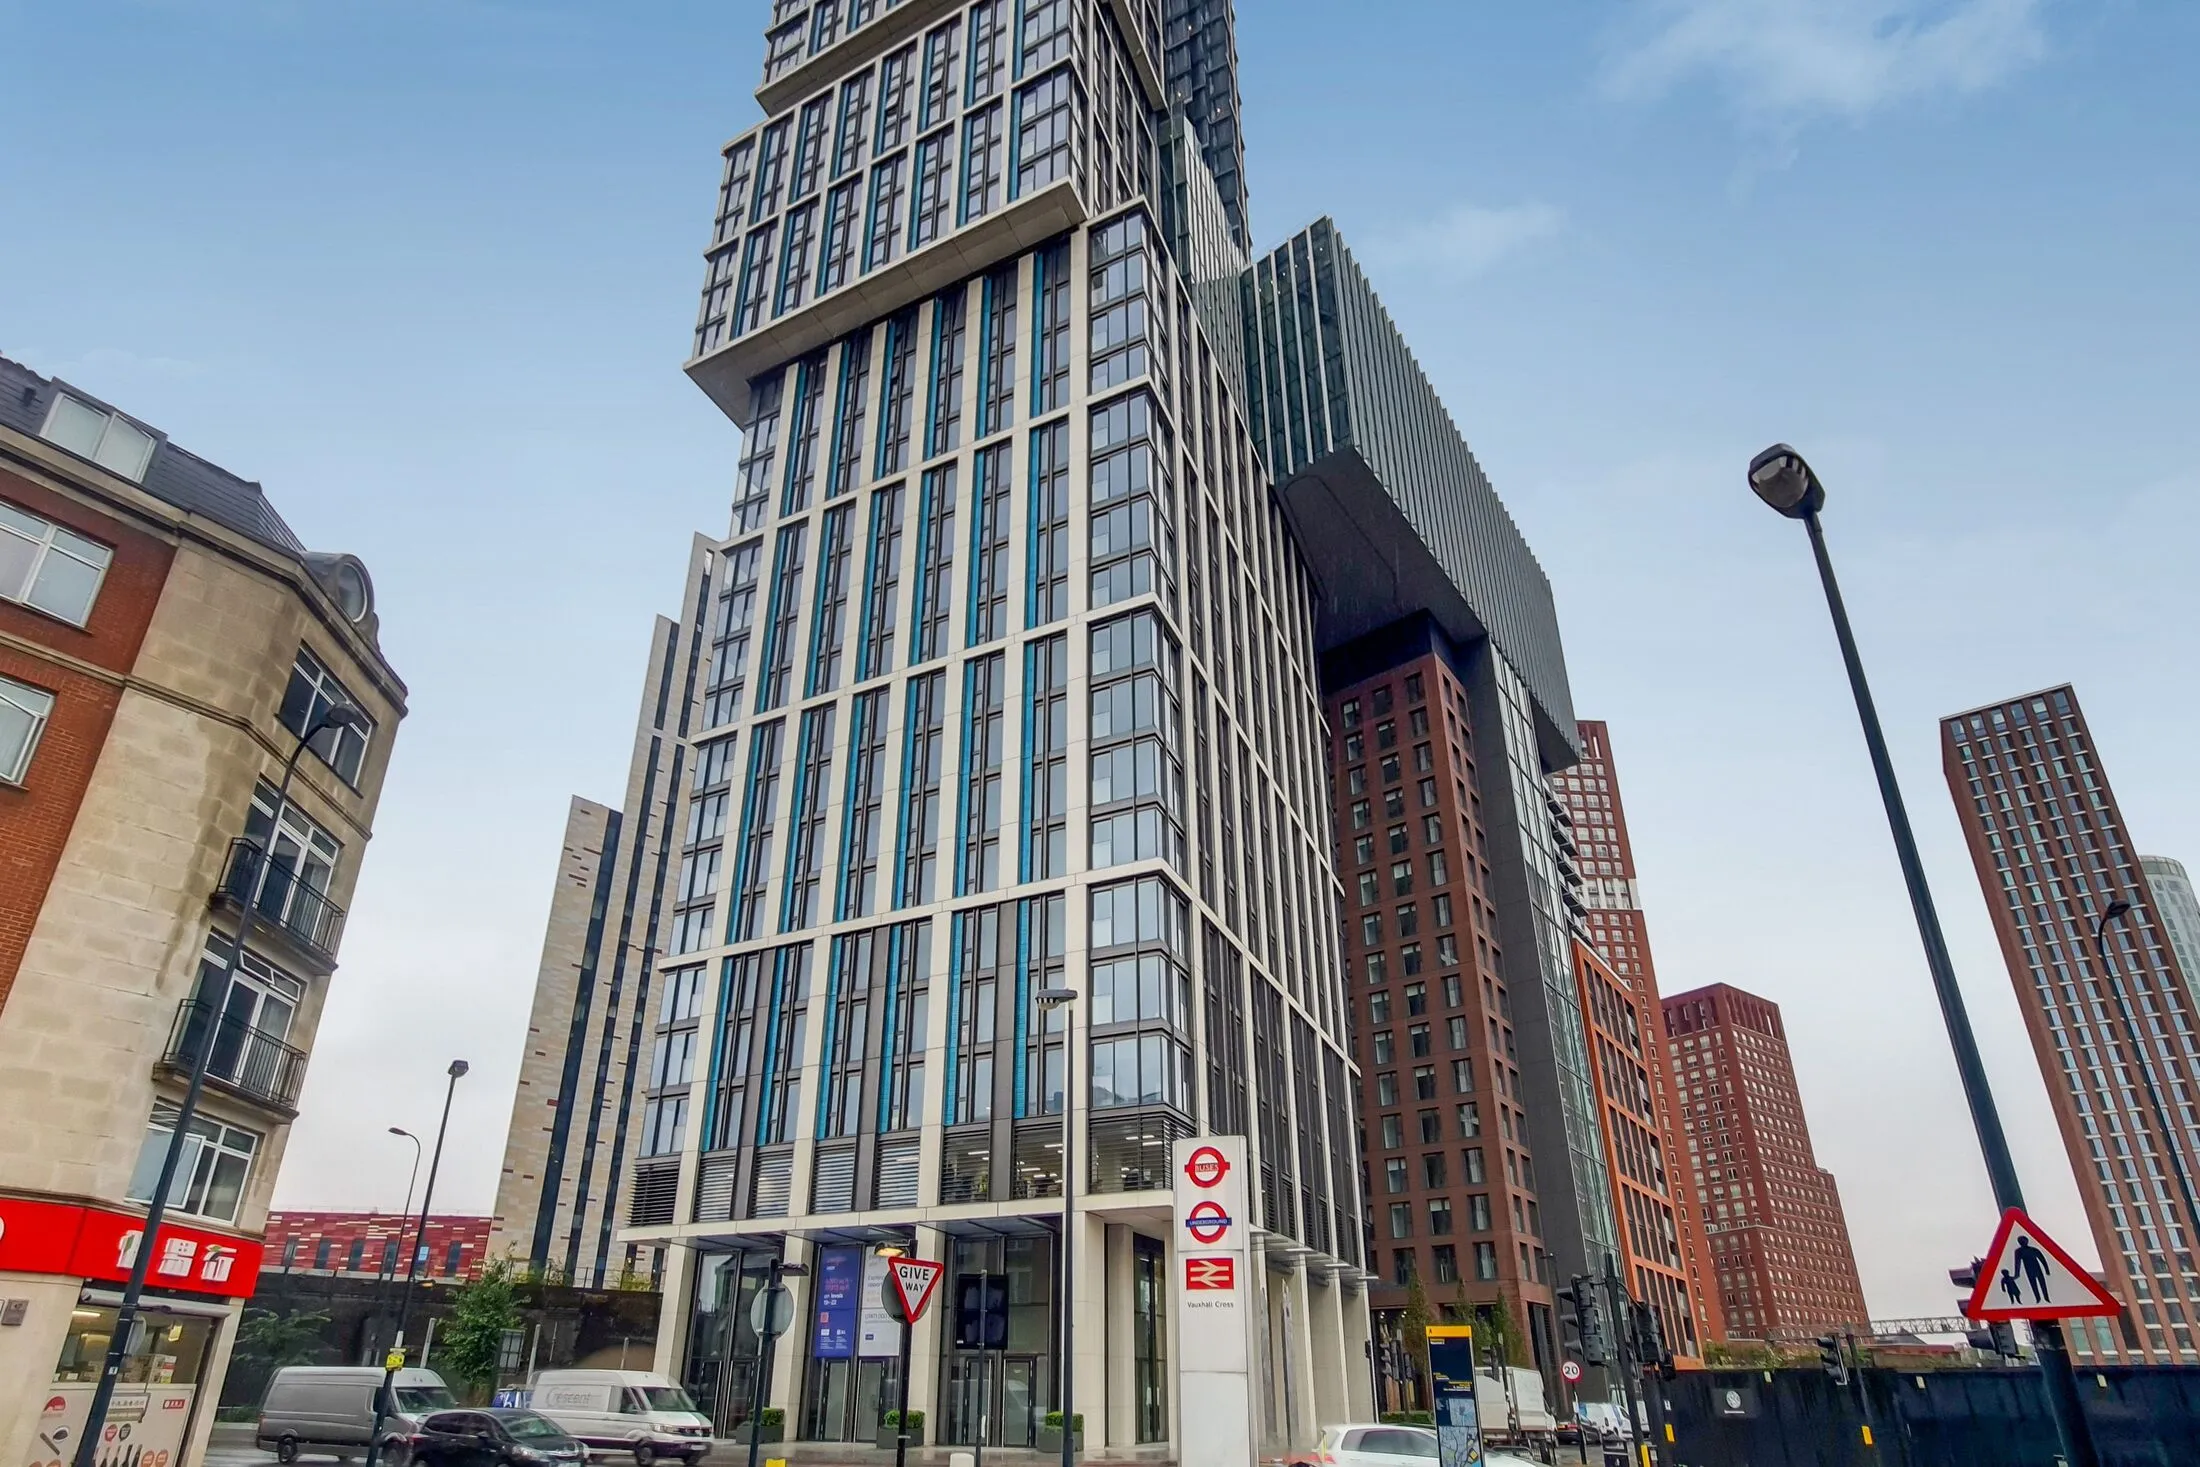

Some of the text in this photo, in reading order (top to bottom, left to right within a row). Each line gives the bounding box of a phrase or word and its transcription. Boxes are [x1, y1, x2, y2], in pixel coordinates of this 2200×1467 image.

[1195, 1163, 1219, 1172] BUSES
[900, 1266, 929, 1281] GIVE
[905, 1282, 924, 1292] WAY
[1564, 1366, 1579, 1375] 20
